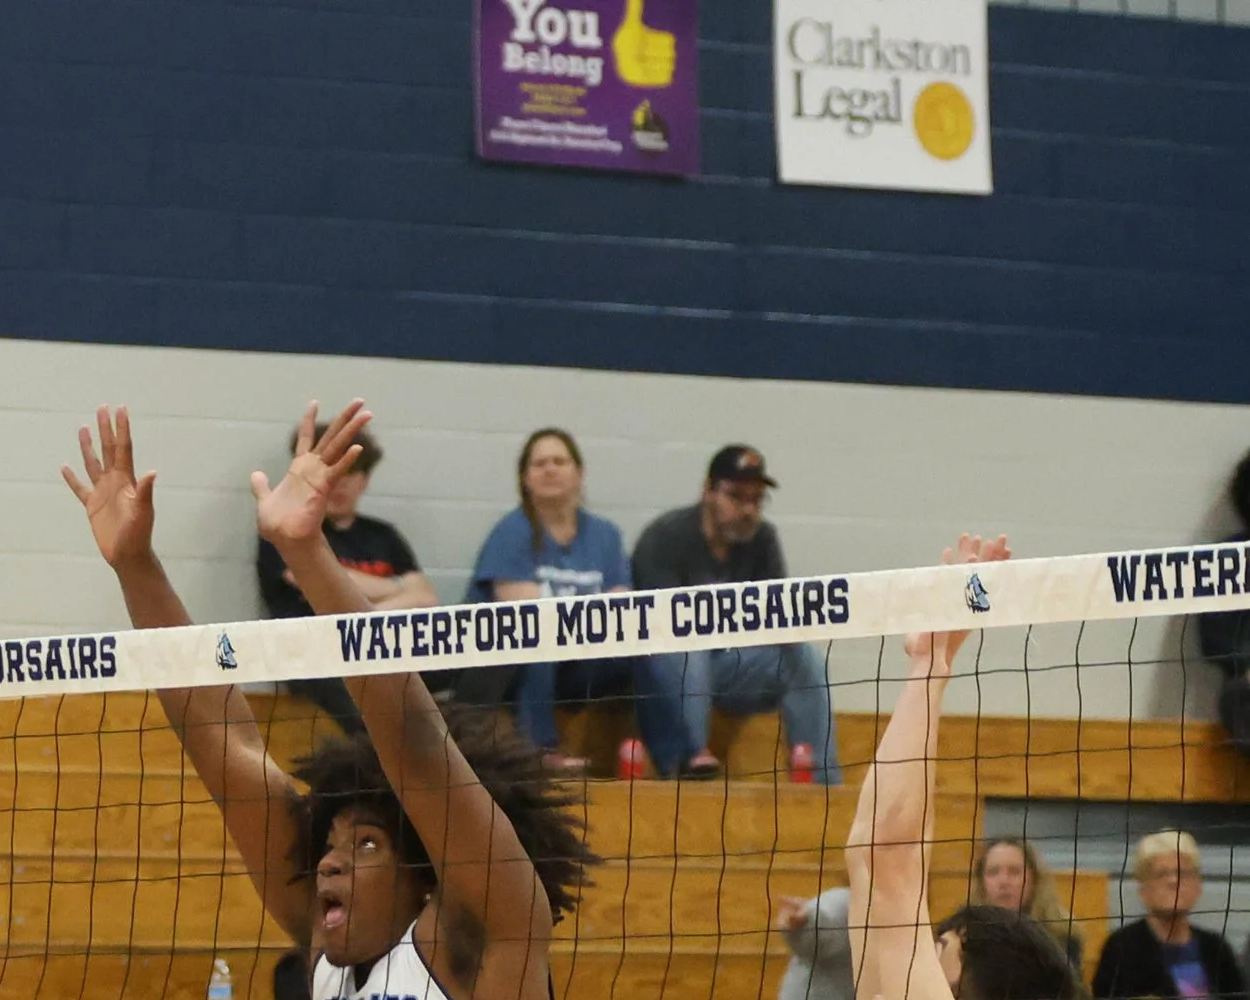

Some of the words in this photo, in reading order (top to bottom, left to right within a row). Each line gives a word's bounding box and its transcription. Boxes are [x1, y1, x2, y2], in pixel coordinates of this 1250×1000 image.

[508, 0, 603, 48] You
[786, 16, 972, 76] Clarkston
[502, 41, 604, 87] Belong
[792, 68, 902, 140] Legal
[337, 604, 540, 662] WATERFORD
[555, 597, 656, 646] MOTT
[671, 578, 850, 638] CORSAIRS
